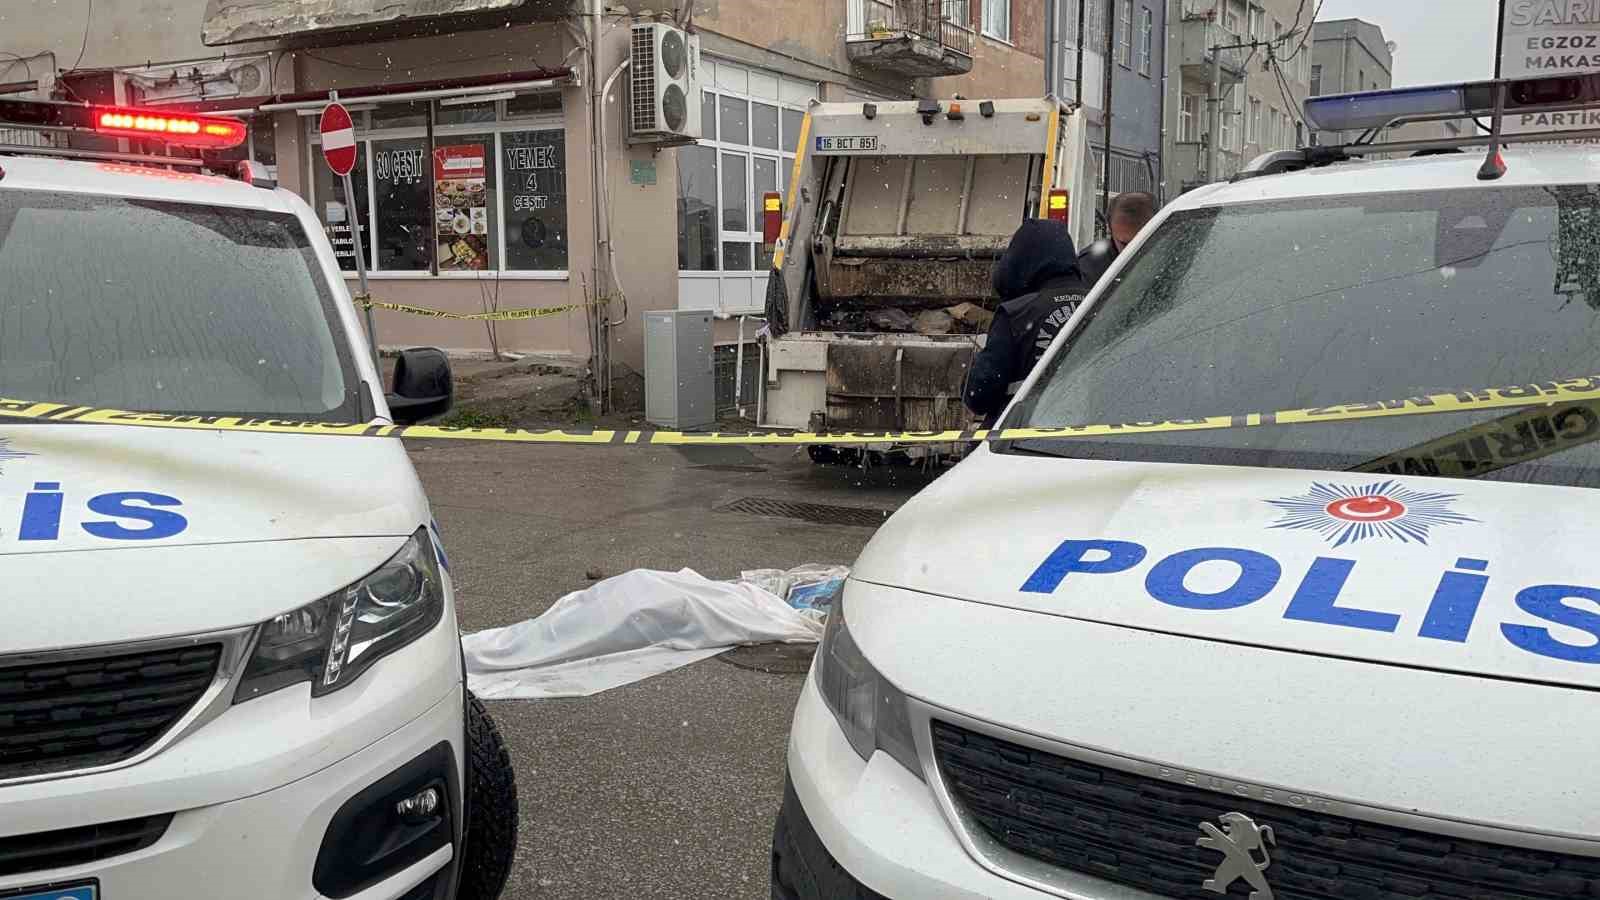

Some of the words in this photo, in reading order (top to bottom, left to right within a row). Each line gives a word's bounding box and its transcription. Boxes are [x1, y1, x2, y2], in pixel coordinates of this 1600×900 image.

[1527, 35, 1597, 49] EGZOZ
[1525, 54, 1600, 69] MAKAS
[823, 138, 832, 148] 16
[837, 138, 854, 148] BCT
[376, 151, 390, 180] 30
[507, 147, 555, 170] YEMEK
[527, 172, 537, 192] 4
[1018, 538, 1600, 665] POLİS
